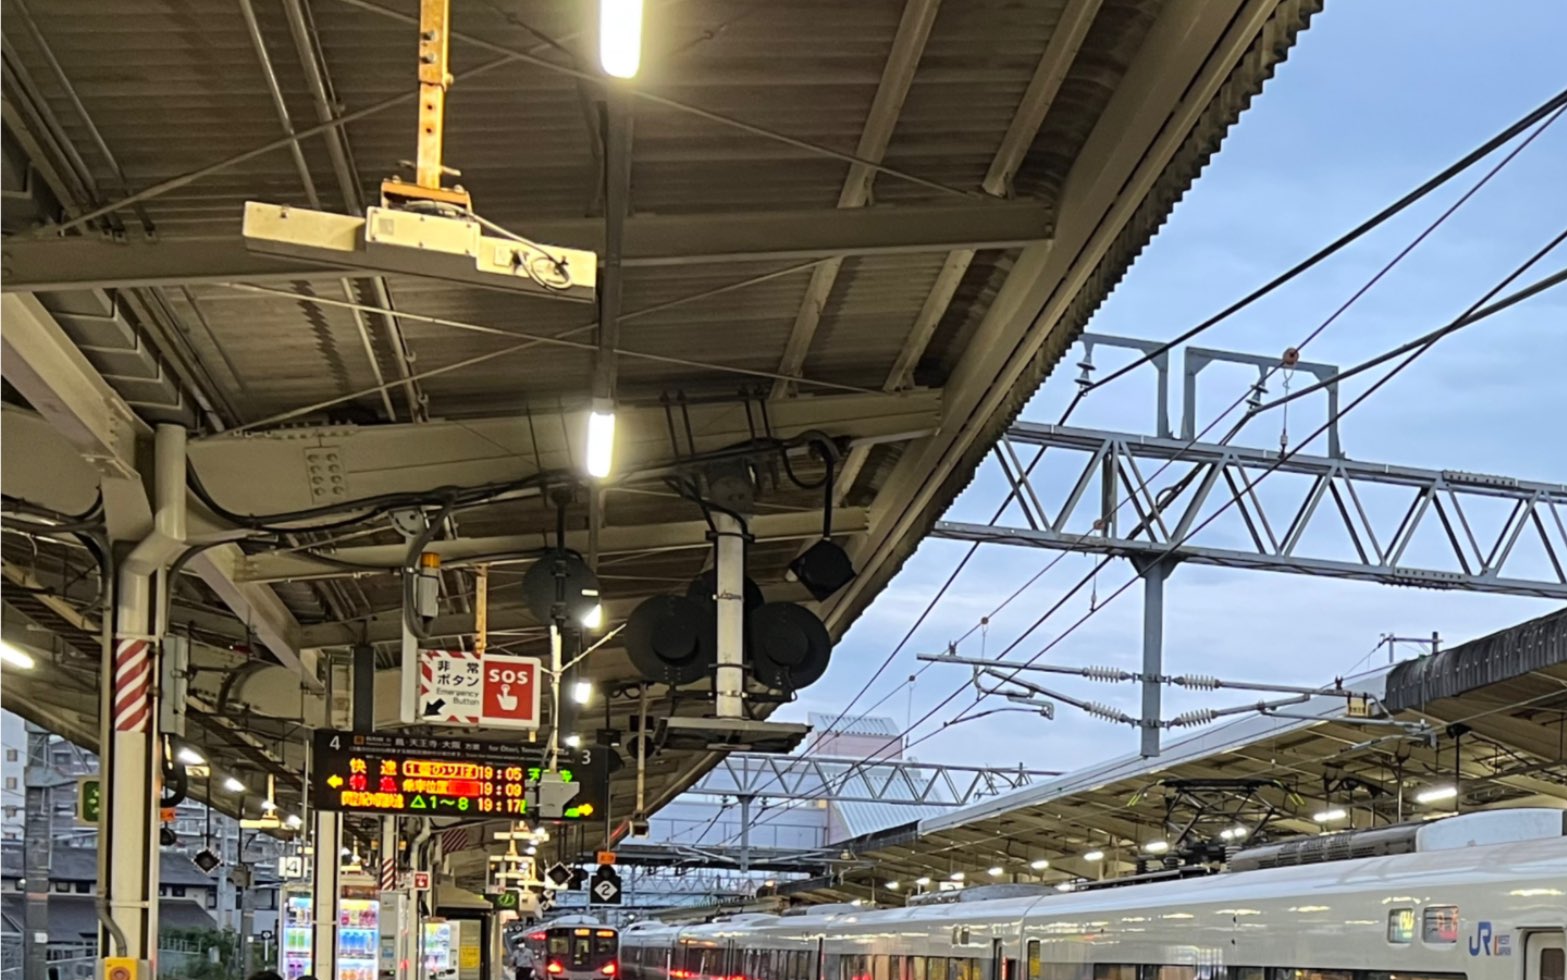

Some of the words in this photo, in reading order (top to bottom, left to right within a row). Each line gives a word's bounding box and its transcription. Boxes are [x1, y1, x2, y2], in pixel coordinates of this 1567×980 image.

[437, 660, 479, 674] 非常
[437, 674, 479, 687] ボタン
[489, 669, 528, 685] SOS
[436, 687, 479, 698] Emergency
[453, 696, 479, 705] Button
[329, 735, 341, 751] 4
[581, 749, 592, 765] 3
[478, 766, 523, 781] 19:05
[478, 797, 521, 813] 19:17
[601, 883, 611, 896] 2
[1468, 921, 1492, 957] JR
